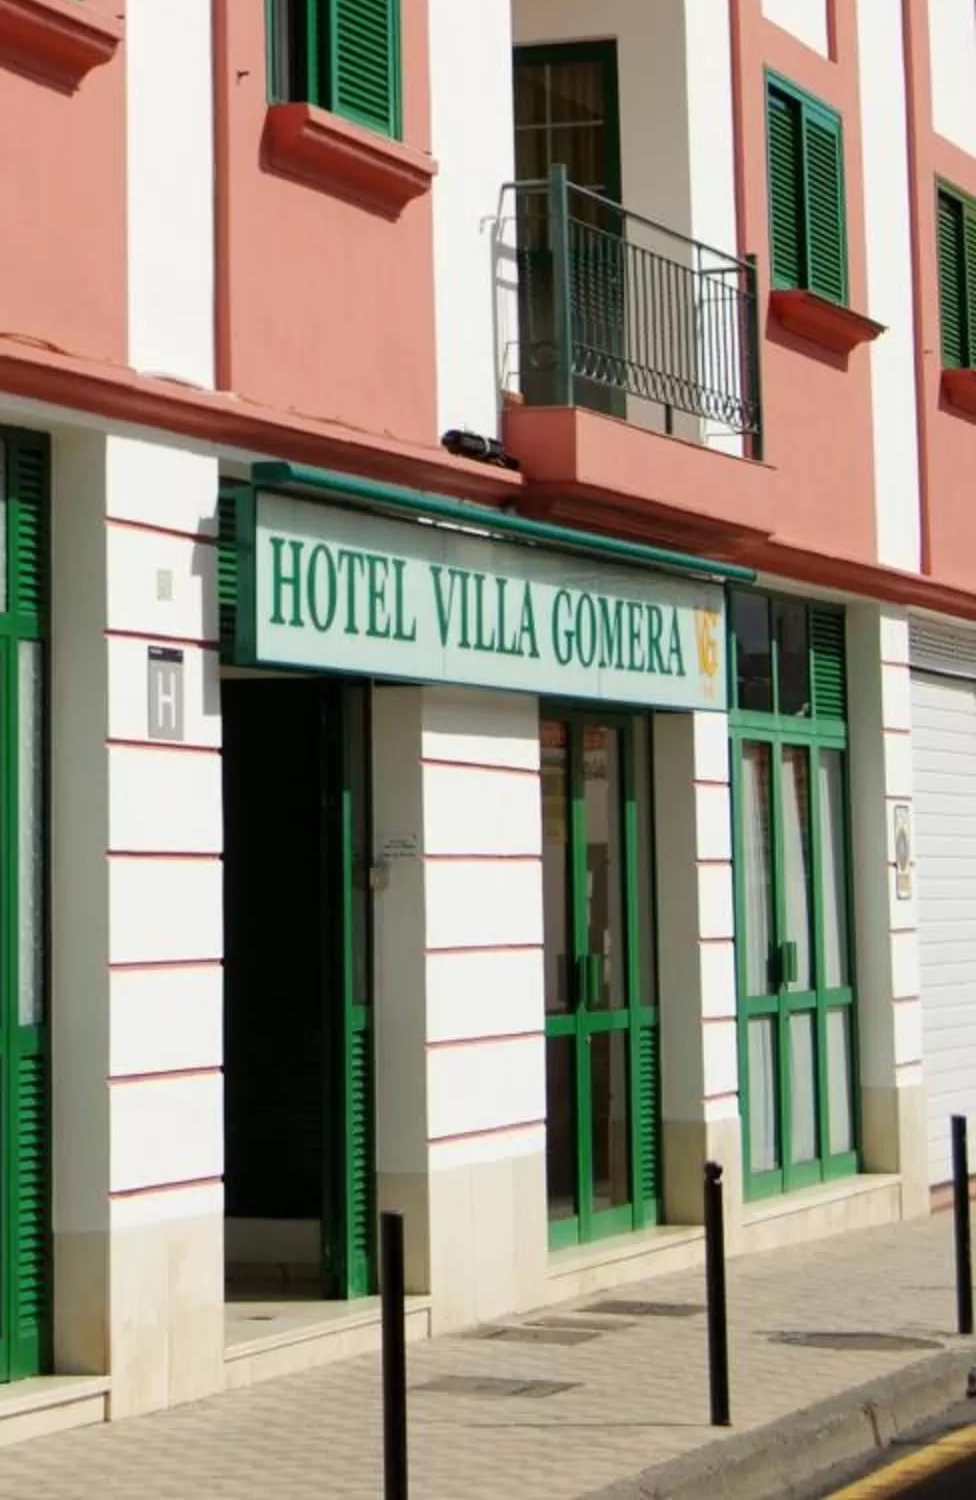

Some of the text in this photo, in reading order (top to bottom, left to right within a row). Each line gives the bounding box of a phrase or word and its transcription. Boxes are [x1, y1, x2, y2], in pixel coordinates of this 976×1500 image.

[269, 536, 416, 642] HOTEL
[430, 564, 539, 660] VILLA
[551, 589, 686, 677] GOMERA
[156, 670, 177, 730] H
